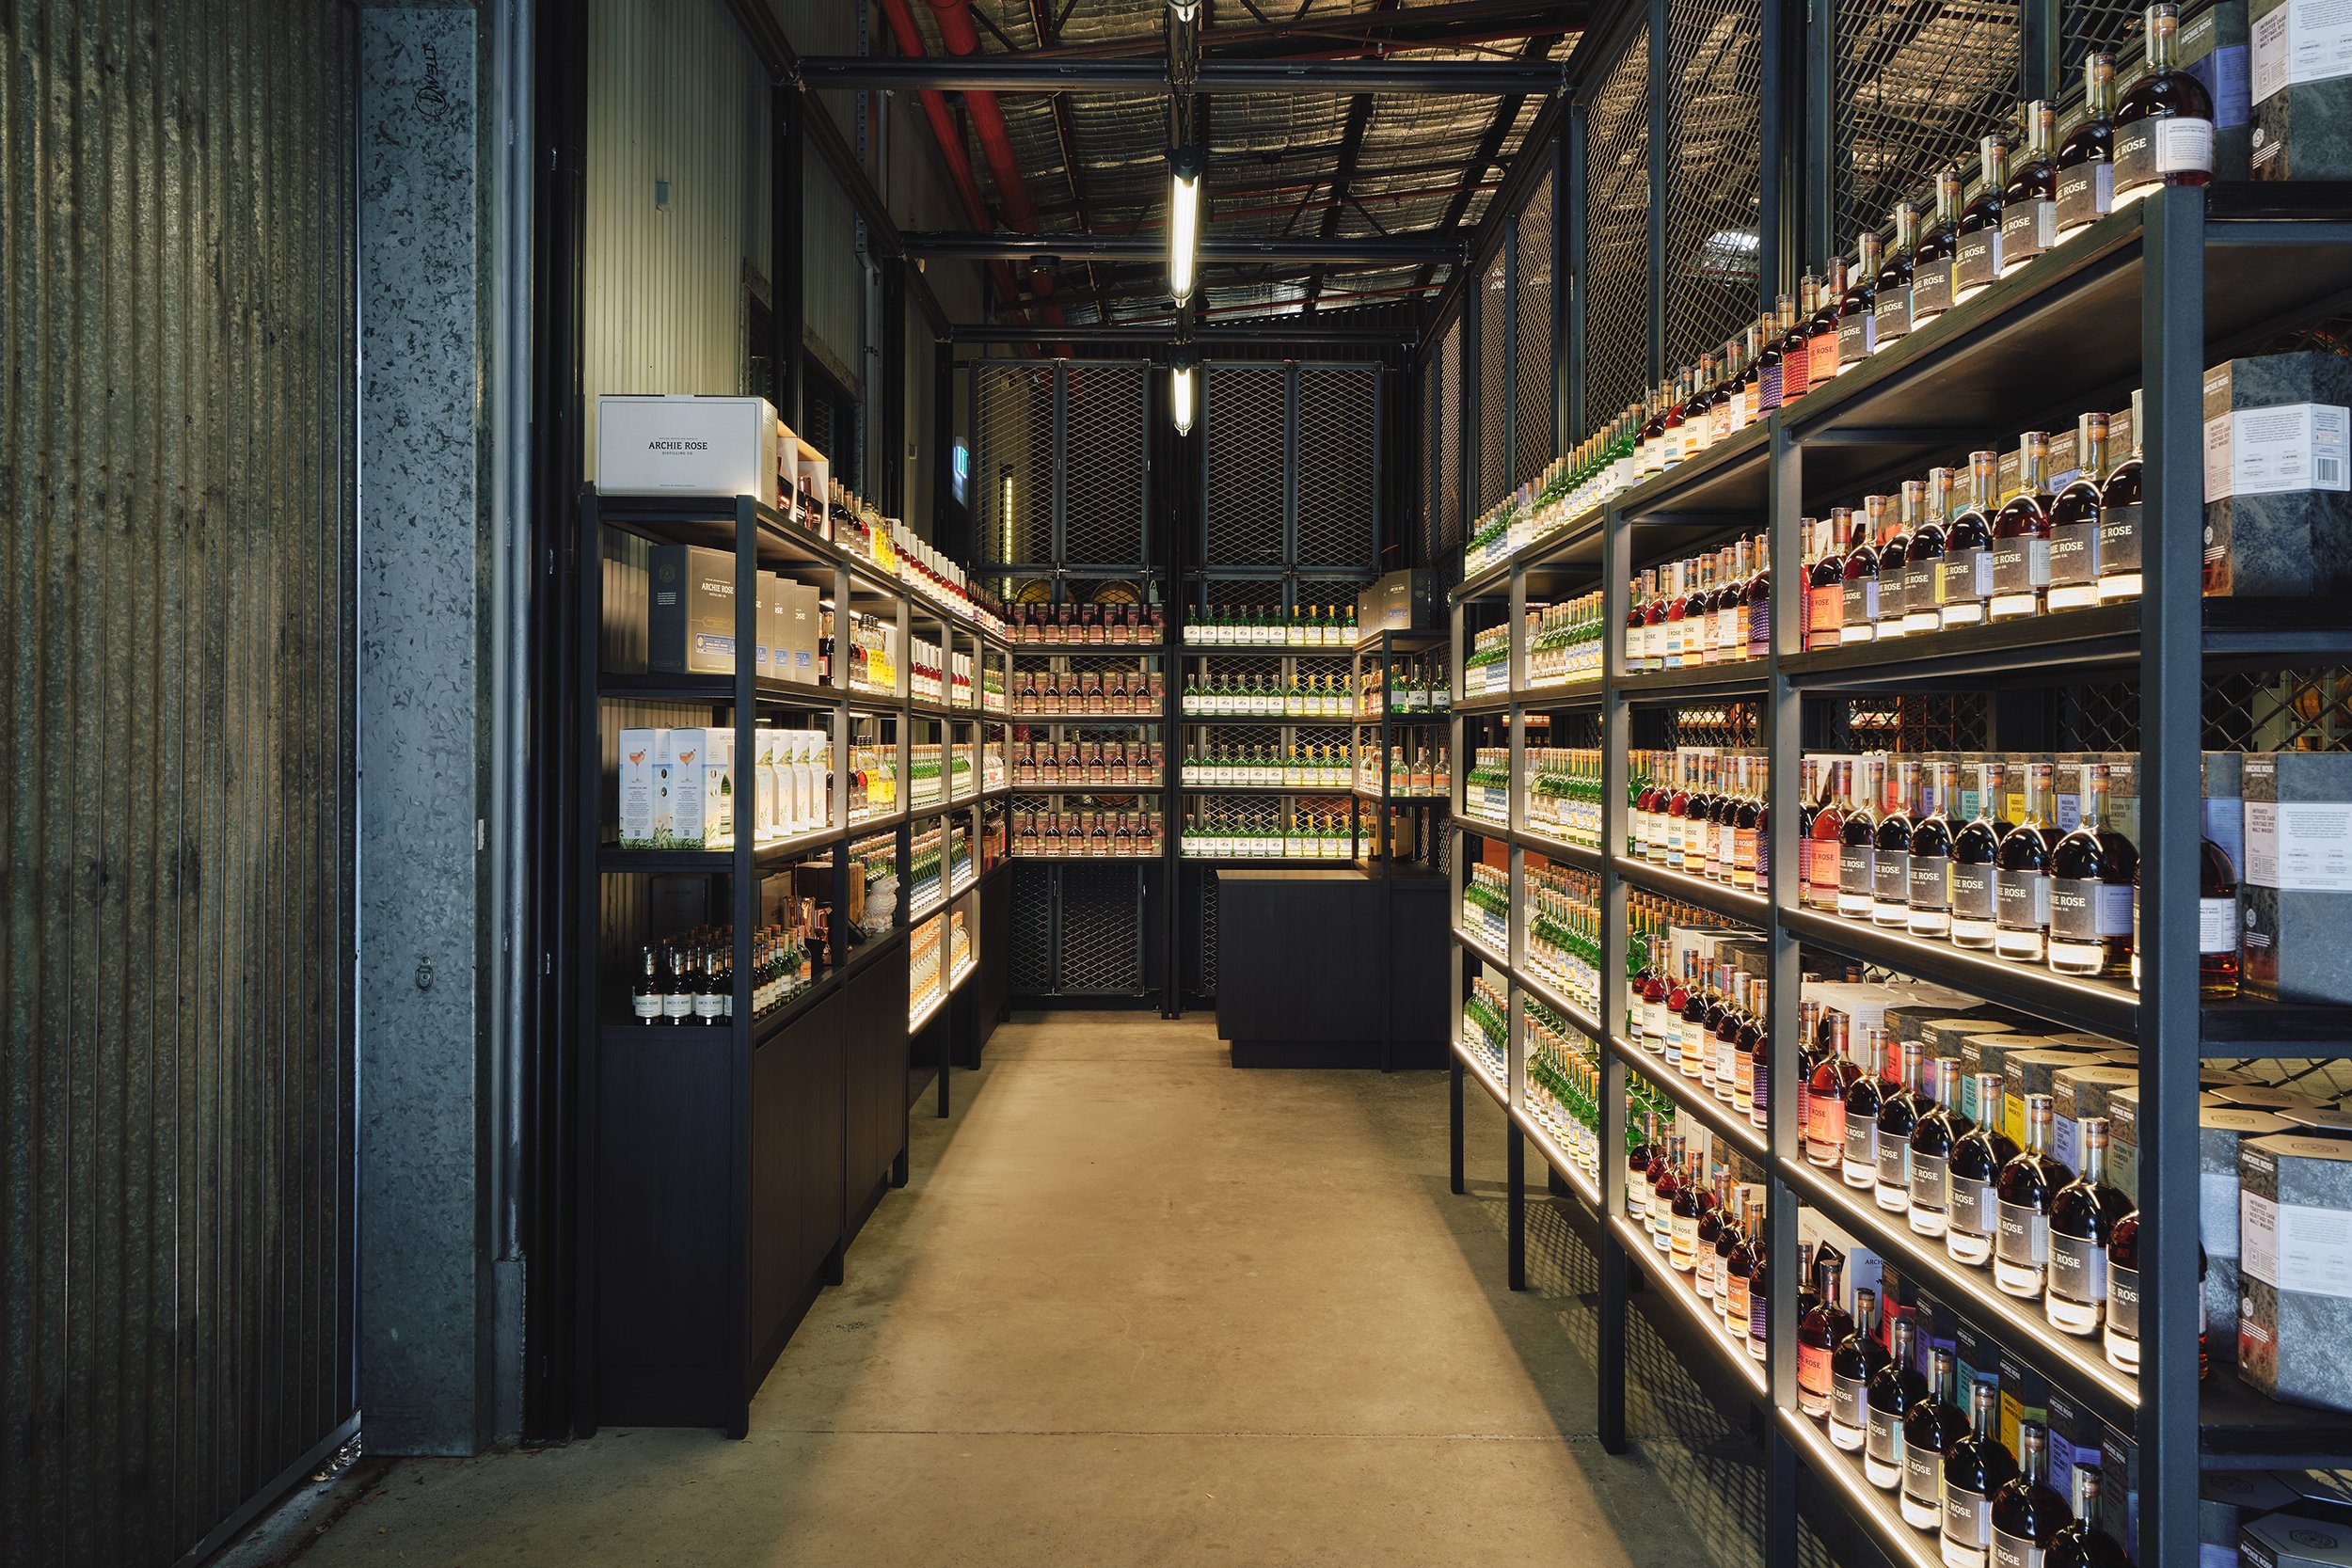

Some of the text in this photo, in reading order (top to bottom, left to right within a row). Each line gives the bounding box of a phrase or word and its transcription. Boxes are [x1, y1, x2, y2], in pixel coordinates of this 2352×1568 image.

[2181, 18, 2213, 44] ARCHIE ROSE
[423, 42, 439, 88] ITEM
[2121, 138, 2146, 155] ROSE
[2063, 180, 2088, 196] ROSE
[2008, 217, 2030, 230] ROSE
[1964, 245, 1985, 258] ROSE
[1923, 274, 1944, 287] ROSE
[1883, 301, 1903, 313] ROSE
[1843, 327, 1861, 336] ROSE
[1816, 346, 1833, 356] ROSE
[2109, 525, 2132, 538] ROSE
[2060, 541, 2084, 552] ROSE
[2000, 553, 2021, 563] ROSE
[1950, 565, 1969, 575] ROSE
[1911, 575, 1928, 583] ROSE
[702, 583, 734, 594] ARCHIE ROSE
[1884, 583, 1901, 591] ROSE
[1962, 880, 1984, 889] ROSE
[2005, 888, 2026, 898] ROSE
[2061, 897, 2085, 907] ROSE
[1811, 1108, 1826, 1117] ROSE
[2124, 1111, 2134, 1120] ROSE
[1849, 1129, 1866, 1139] ROSE
[1882, 1148, 1898, 1159] ROSE
[2242, 1153, 2274, 1172] ARCHIE ROSE
[1918, 1169, 1939, 1181] ROSE
[1955, 1194, 1974, 1205] ROSE
[2003, 1221, 2023, 1234] ROSE
[2057, 1254, 2081, 1268] ROSE
[1805, 1359, 1821, 1369] ROSE
[1836, 1392, 1853, 1402] ROSE
[2050, 1398, 2074, 1419] ARCHIE ROSE
[1870, 1425, 1887, 1437] ROSE
[2116, 1452, 2126, 1464] ROSE
[1911, 1463, 1931, 1475] ROSE
[1951, 1504, 1971, 1518] ROSE
[1998, 1550, 2020, 1566] ROSE
[2241, 1543, 2272, 1568] ARCHIE ROSE
